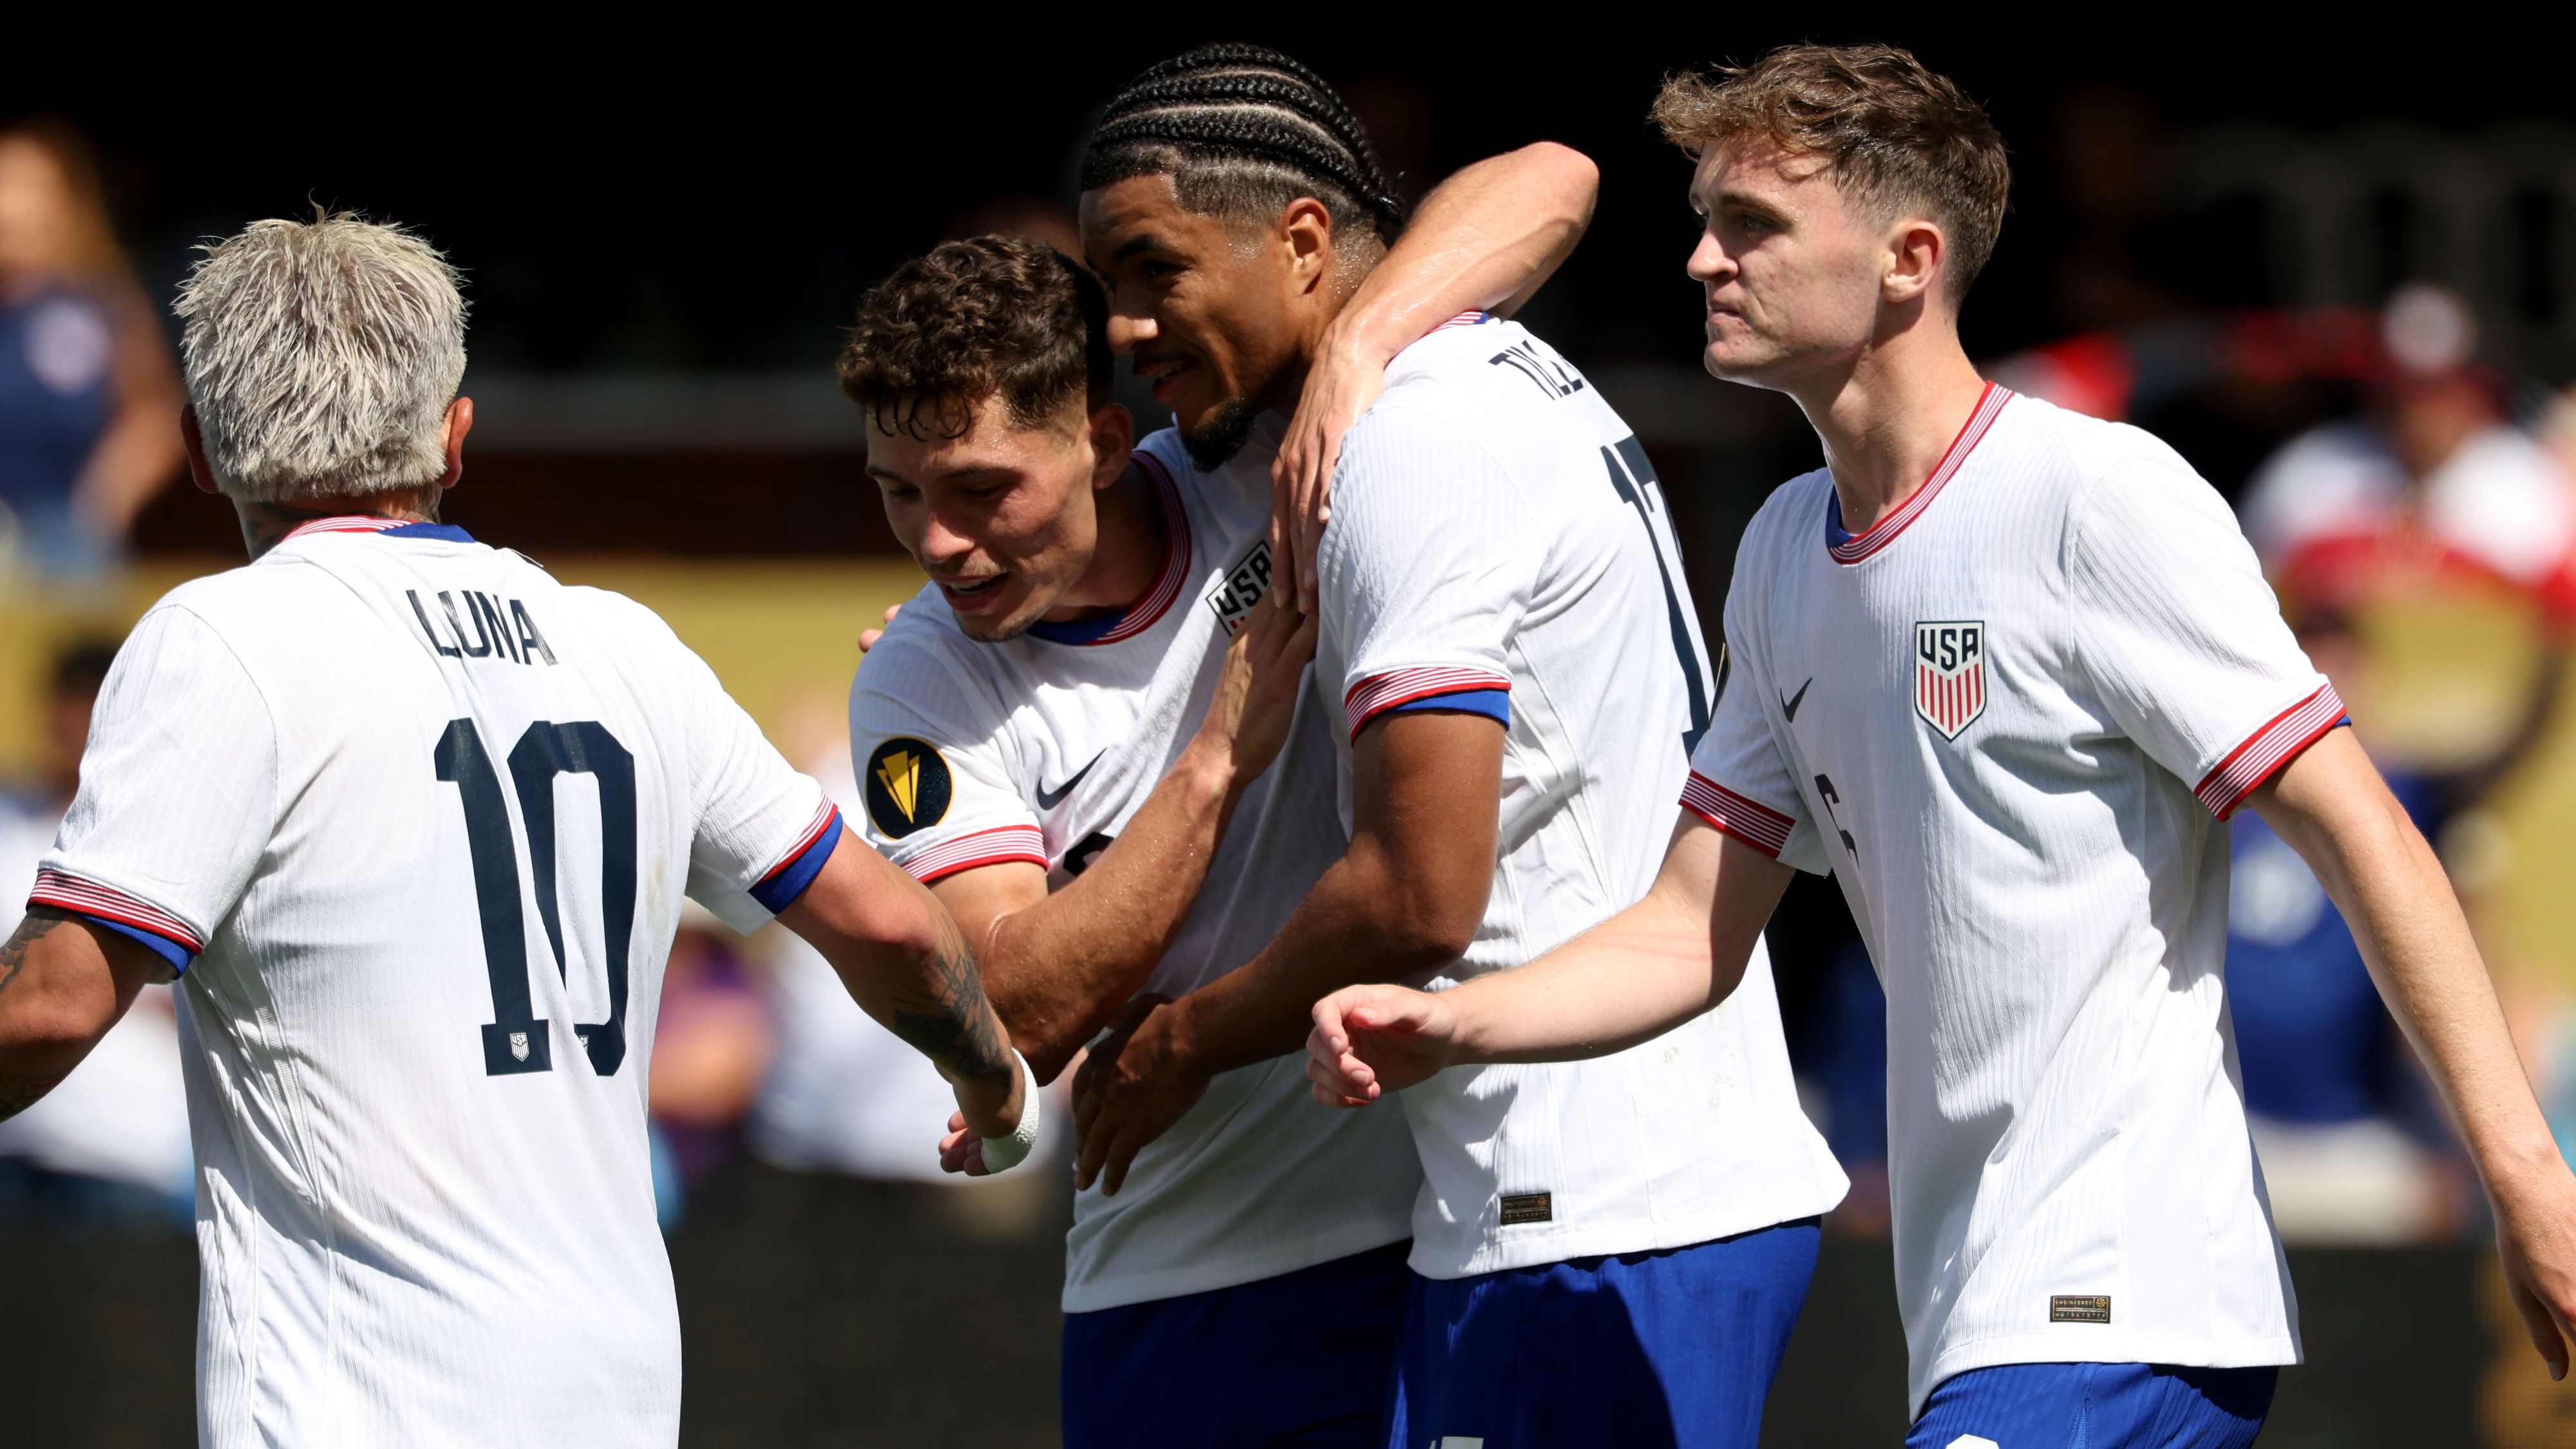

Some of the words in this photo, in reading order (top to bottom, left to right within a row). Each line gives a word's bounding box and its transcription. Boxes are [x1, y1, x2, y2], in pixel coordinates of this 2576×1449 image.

[1215, 550, 1272, 616] USA
[405, 589, 560, 667] LUNA
[1920, 628, 1978, 672] USA
[434, 717, 638, 1076] 10
[511, 1034, 526, 1046] USA
